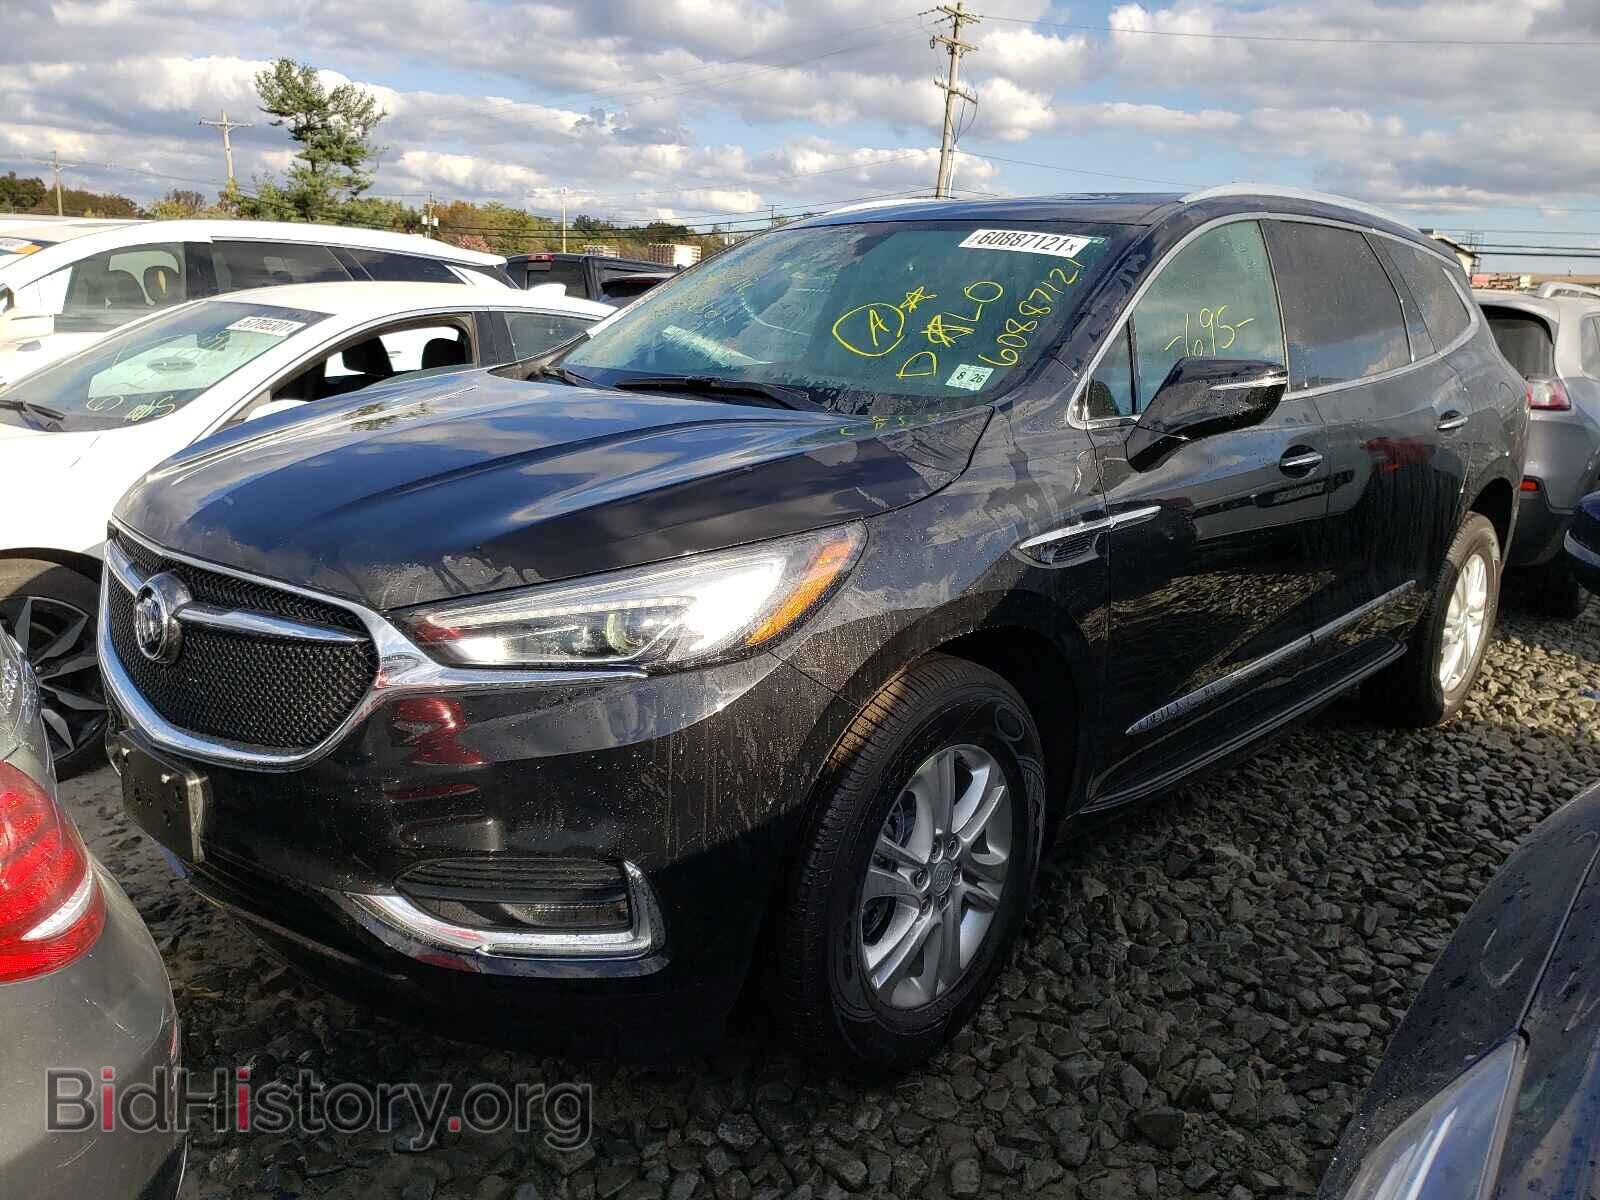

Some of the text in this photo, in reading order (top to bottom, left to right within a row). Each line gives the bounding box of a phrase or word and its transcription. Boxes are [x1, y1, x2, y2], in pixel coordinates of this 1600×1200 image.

[978, 230, 1068, 252] 60887121
[977, 257, 1086, 366] 60887121
[956, 371, 986, 384] 8 26
